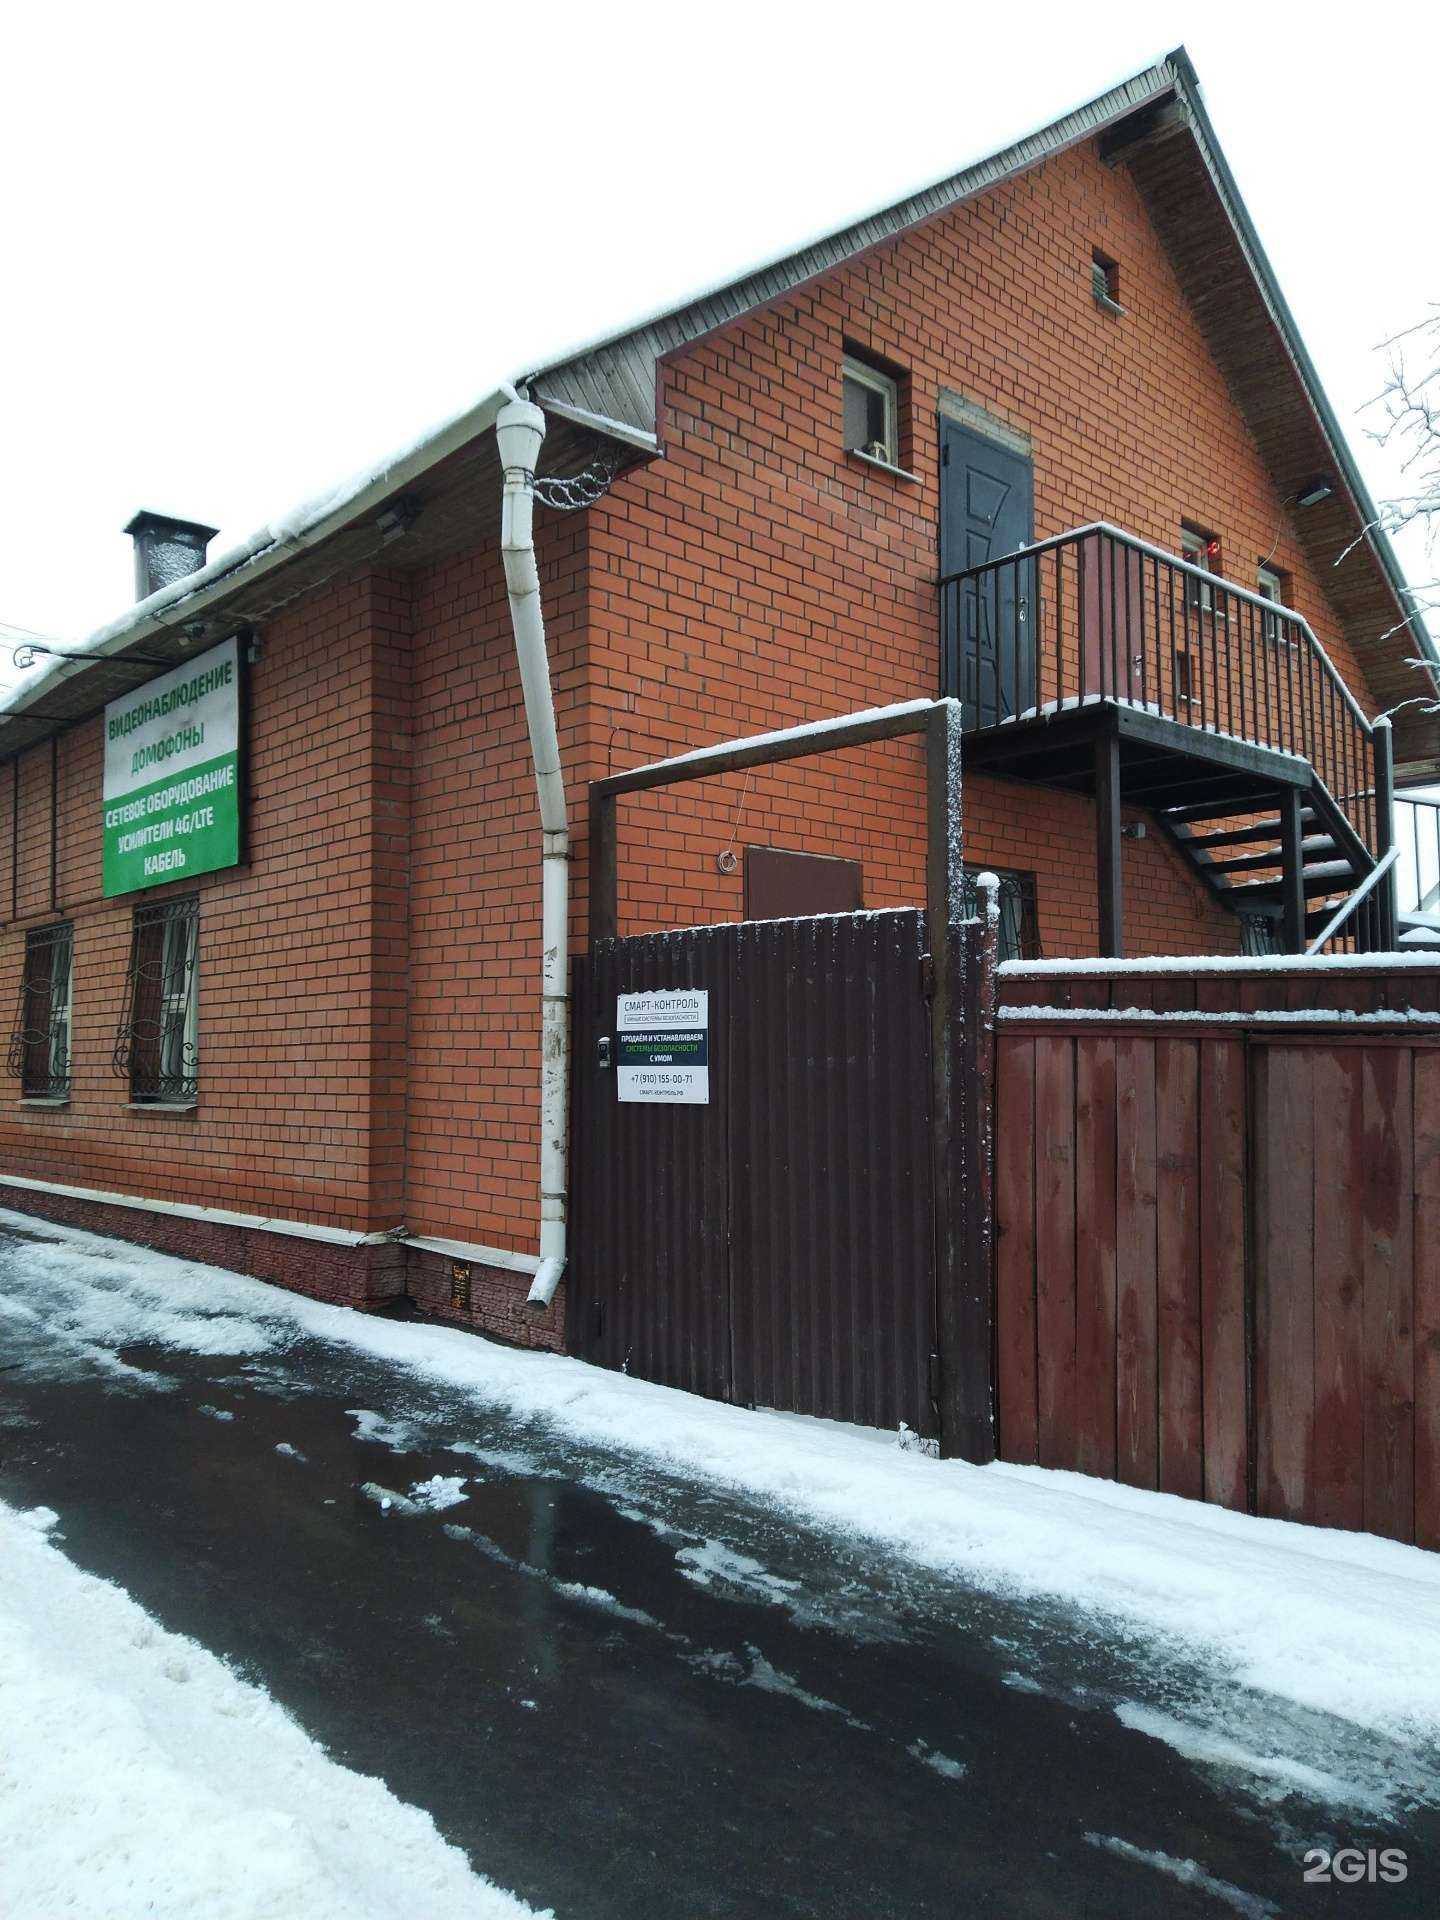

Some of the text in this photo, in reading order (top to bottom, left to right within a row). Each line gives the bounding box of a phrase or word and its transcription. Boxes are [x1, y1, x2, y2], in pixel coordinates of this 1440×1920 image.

[108, 660, 232, 741] ВИДЕОНАБЛЮДЕНИЕ
[131, 722, 204, 776] ДОМОФОНЫ
[105, 764, 234, 828] СЕТЕВОЕ ОБОРУДОВАНИЕ
[118, 806, 214, 854] УСИЛИТЕЛИ 4G/LTE
[144, 848, 186, 876] КАБЕЛЬ
[624, 997, 699, 1011] СМАРТ-КОНТРОЛЬ
[621, 1033, 704, 1043] ПРОДАЁМ И УСТАНАВЛИВАЕМ
[654, 1044, 698, 1052] БЕЗОПАСНОСТИ
[649, 1054, 673, 1062] С УМОМ
[631, 1073, 693, 1084] +7 (910) 155-00-71
